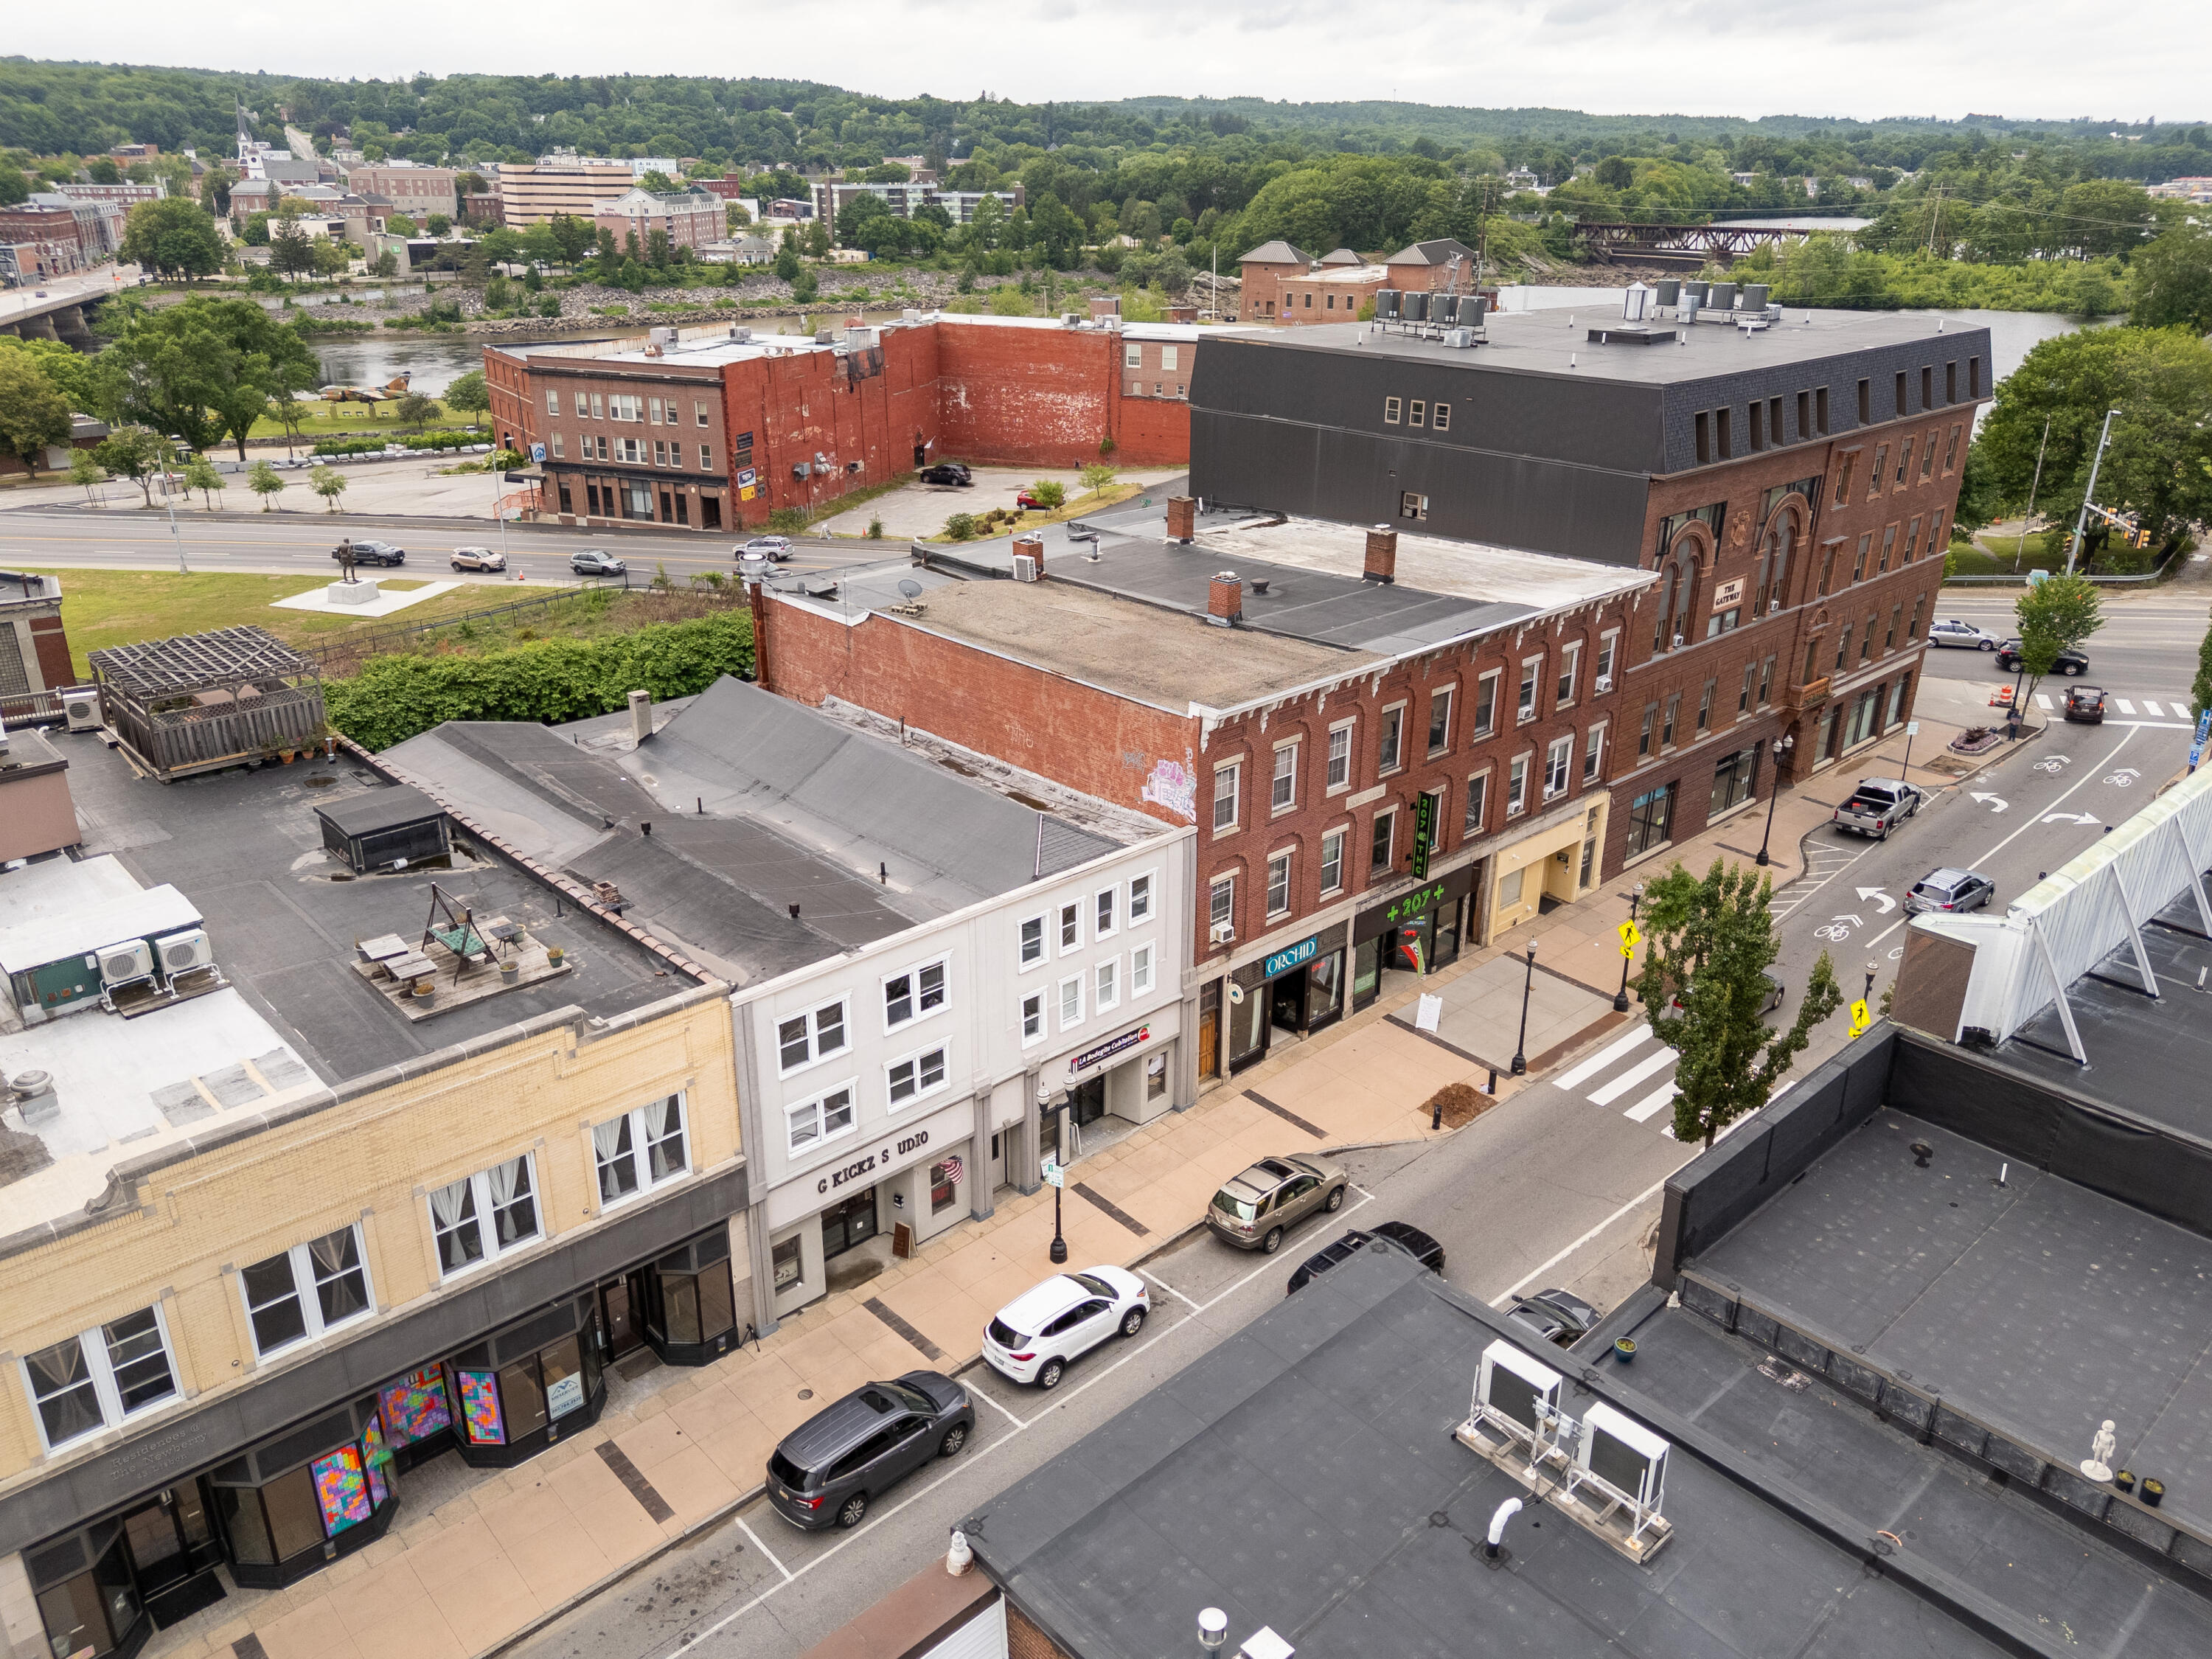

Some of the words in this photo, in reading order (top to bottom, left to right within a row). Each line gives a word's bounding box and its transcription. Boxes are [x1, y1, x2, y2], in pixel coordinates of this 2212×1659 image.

[1716, 591, 1740, 605] GATEWAY
[1725, 584, 1735, 594] THE
[2201, 710, 2211, 725] H
[1420, 799, 1428, 828] 207
[1402, 888, 1430, 917] 207
[1267, 941, 1315, 973] ORCHID
[1087, 1046, 1110, 1060] Bodegita
[818, 1178, 827, 1194] G
[832, 1155, 875, 1188] KICKZ
[111, 1464, 136, 1481] The
[142, 1433, 206, 1464] Newberry
[112, 1430, 186, 1467] Residences
